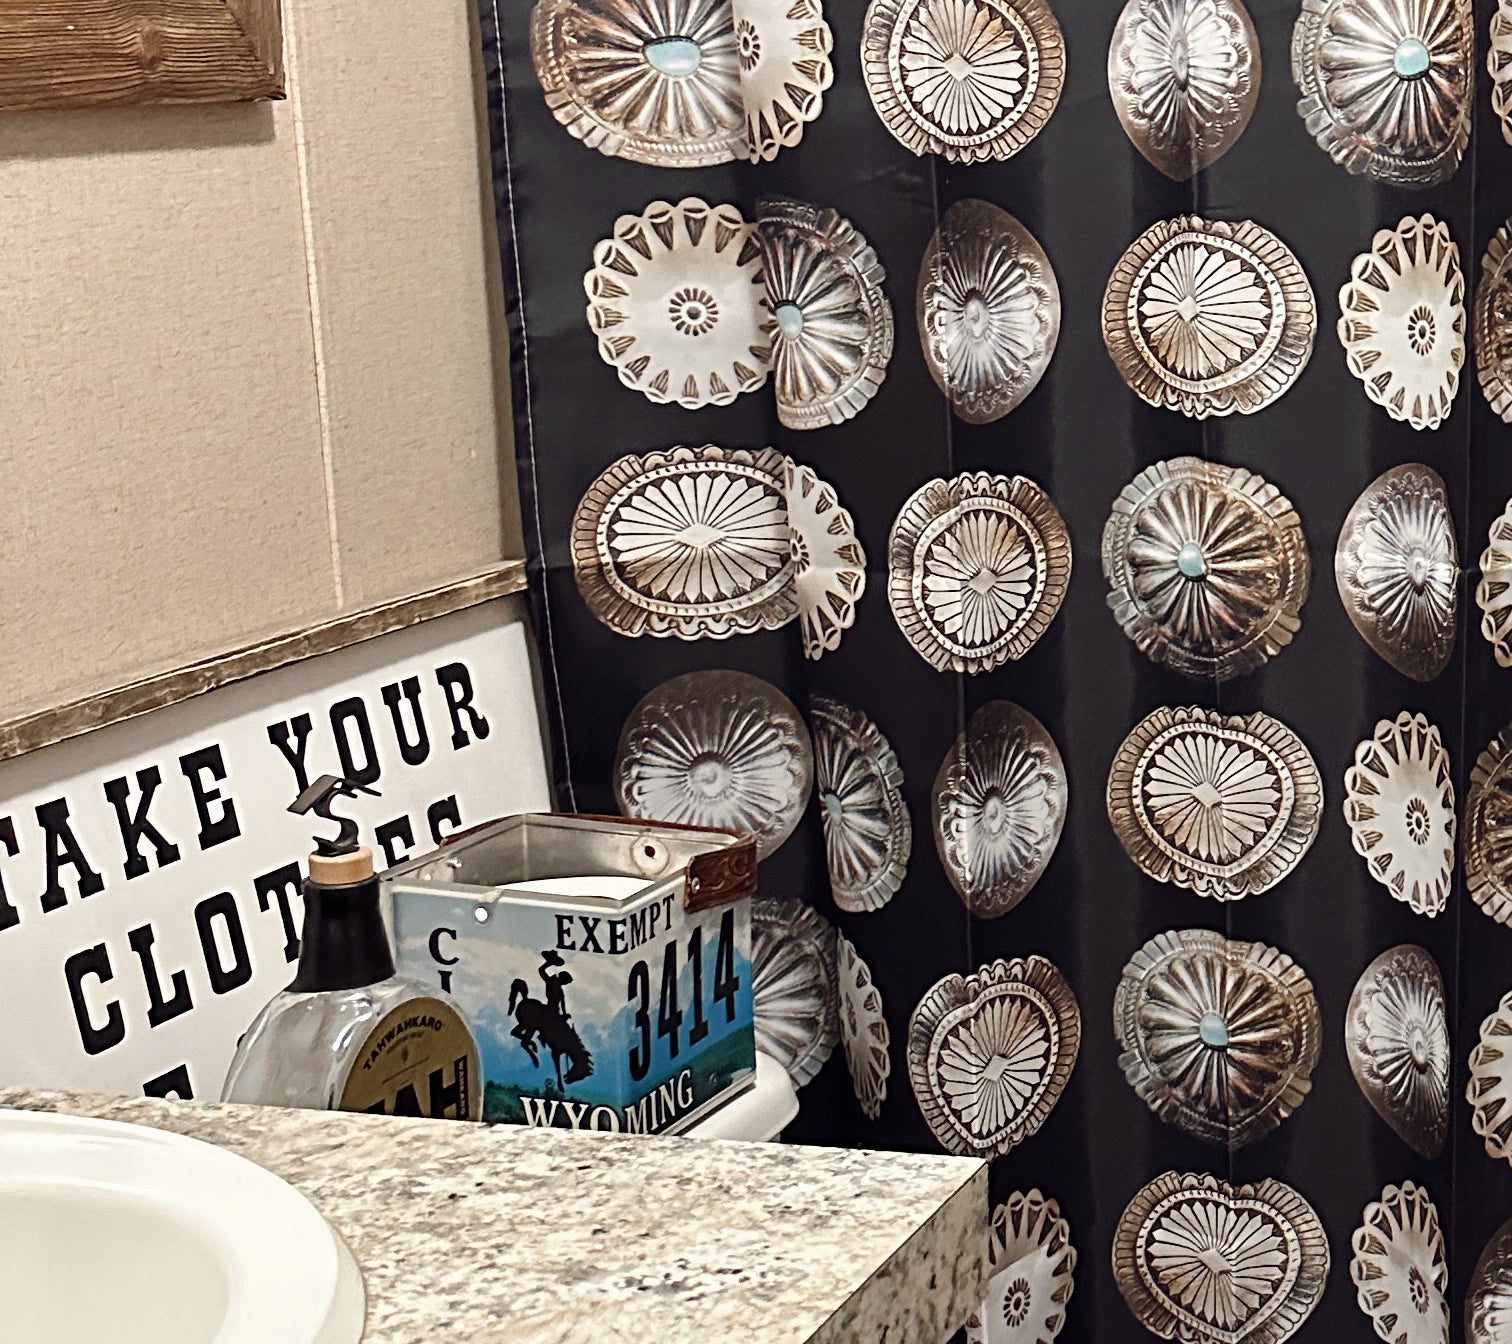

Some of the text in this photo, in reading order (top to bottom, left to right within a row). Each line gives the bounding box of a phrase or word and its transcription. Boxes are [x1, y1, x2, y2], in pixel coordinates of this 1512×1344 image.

[267, 662, 489, 800] YOUR
[555, 893, 674, 955] EXEMPT
[628, 908, 739, 1081] 3414
[520, 1069, 694, 1135] WYOMING
